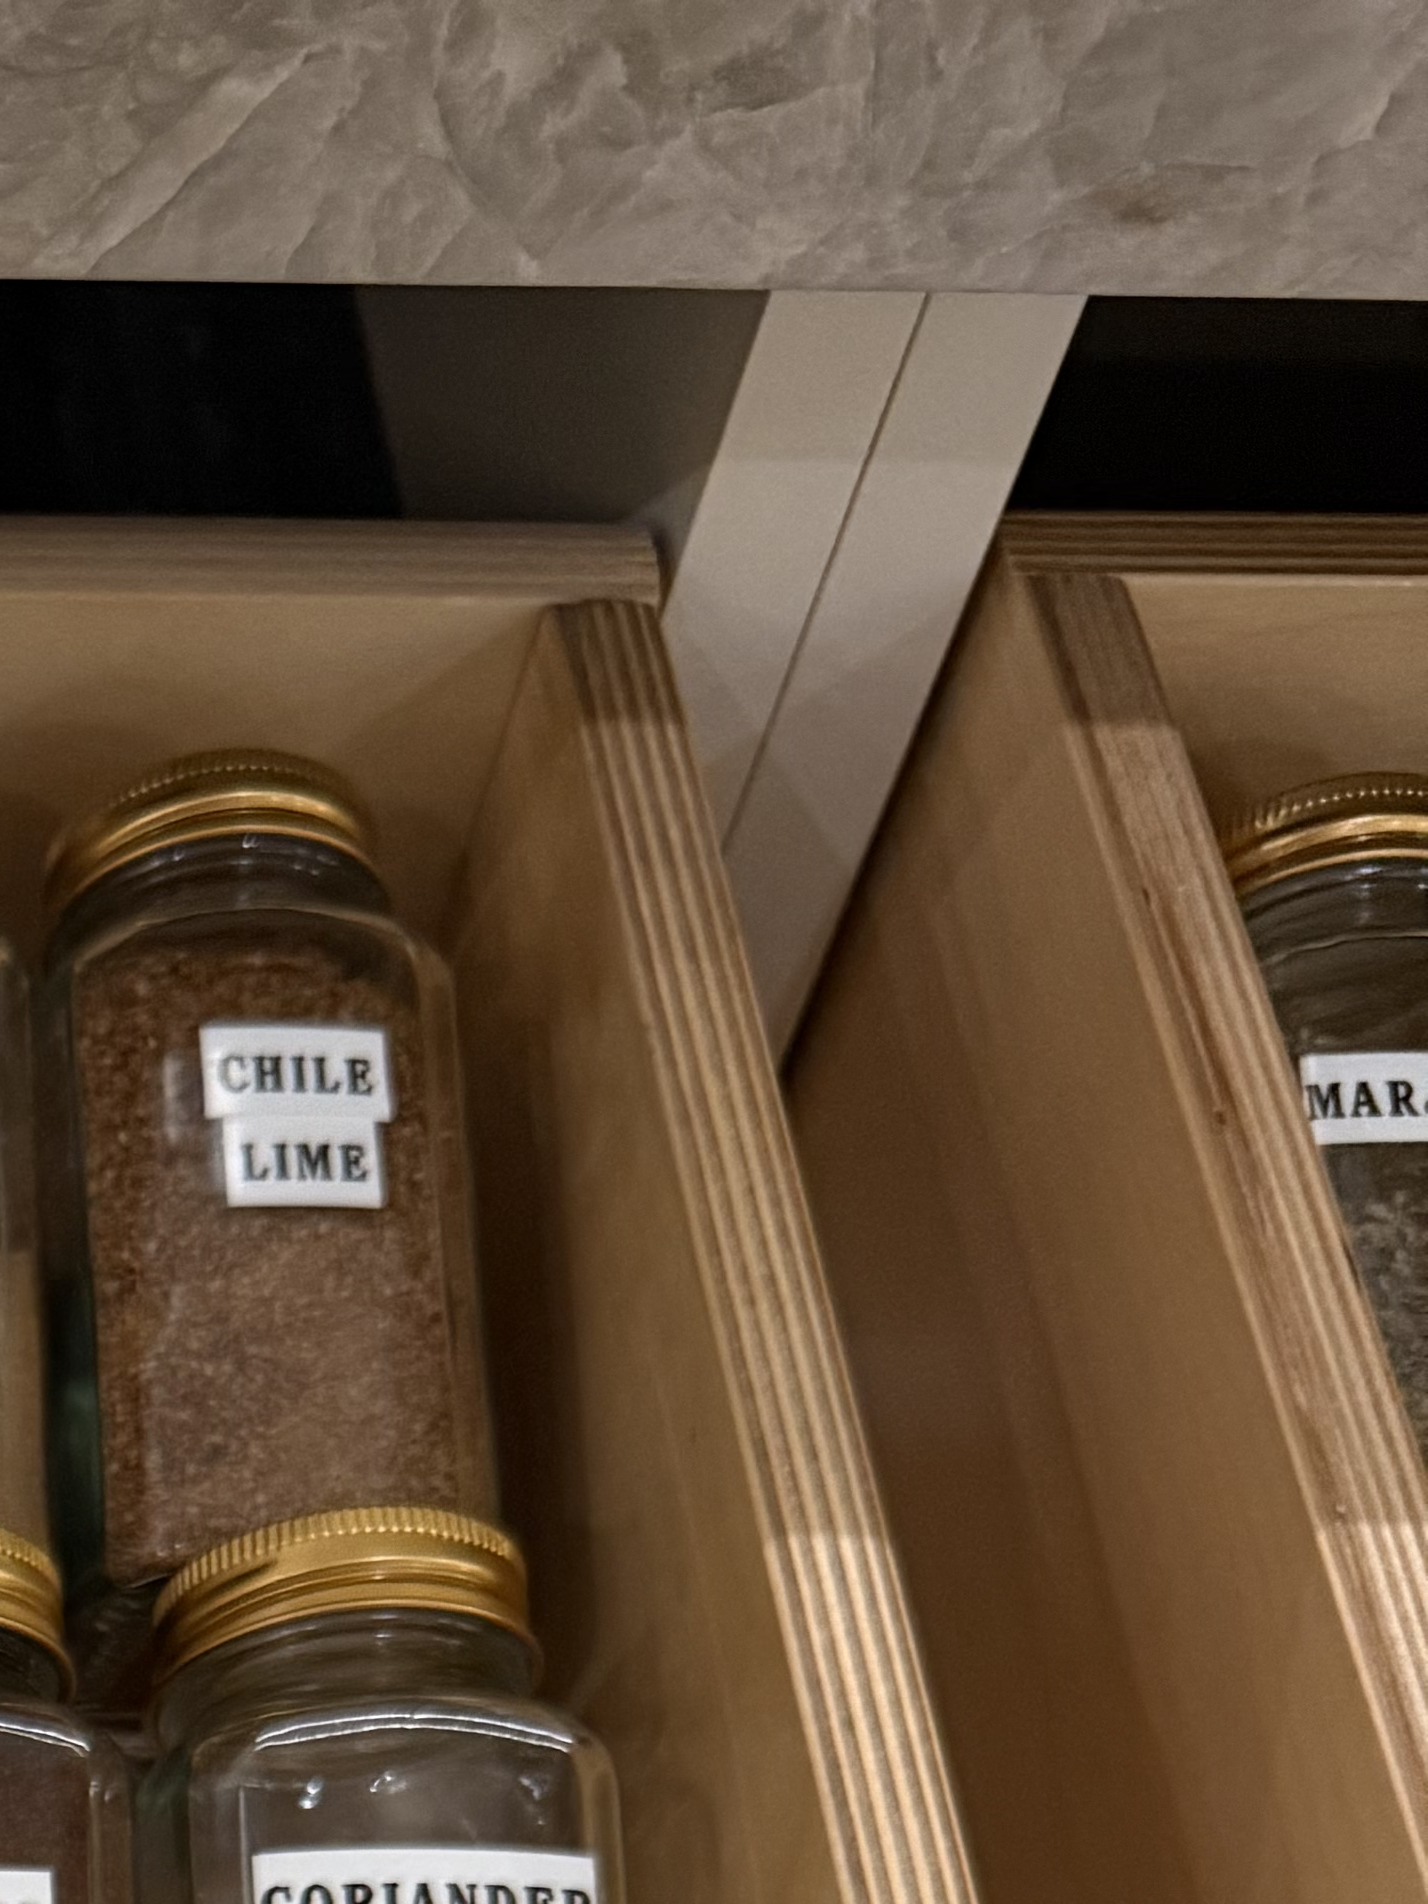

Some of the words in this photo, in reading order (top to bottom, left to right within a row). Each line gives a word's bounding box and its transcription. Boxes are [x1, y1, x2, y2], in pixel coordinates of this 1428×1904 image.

[217, 1052, 376, 1095] CHILE
[1304, 1080, 1428, 1120] MAR
[244, 1143, 368, 1181] LIME
